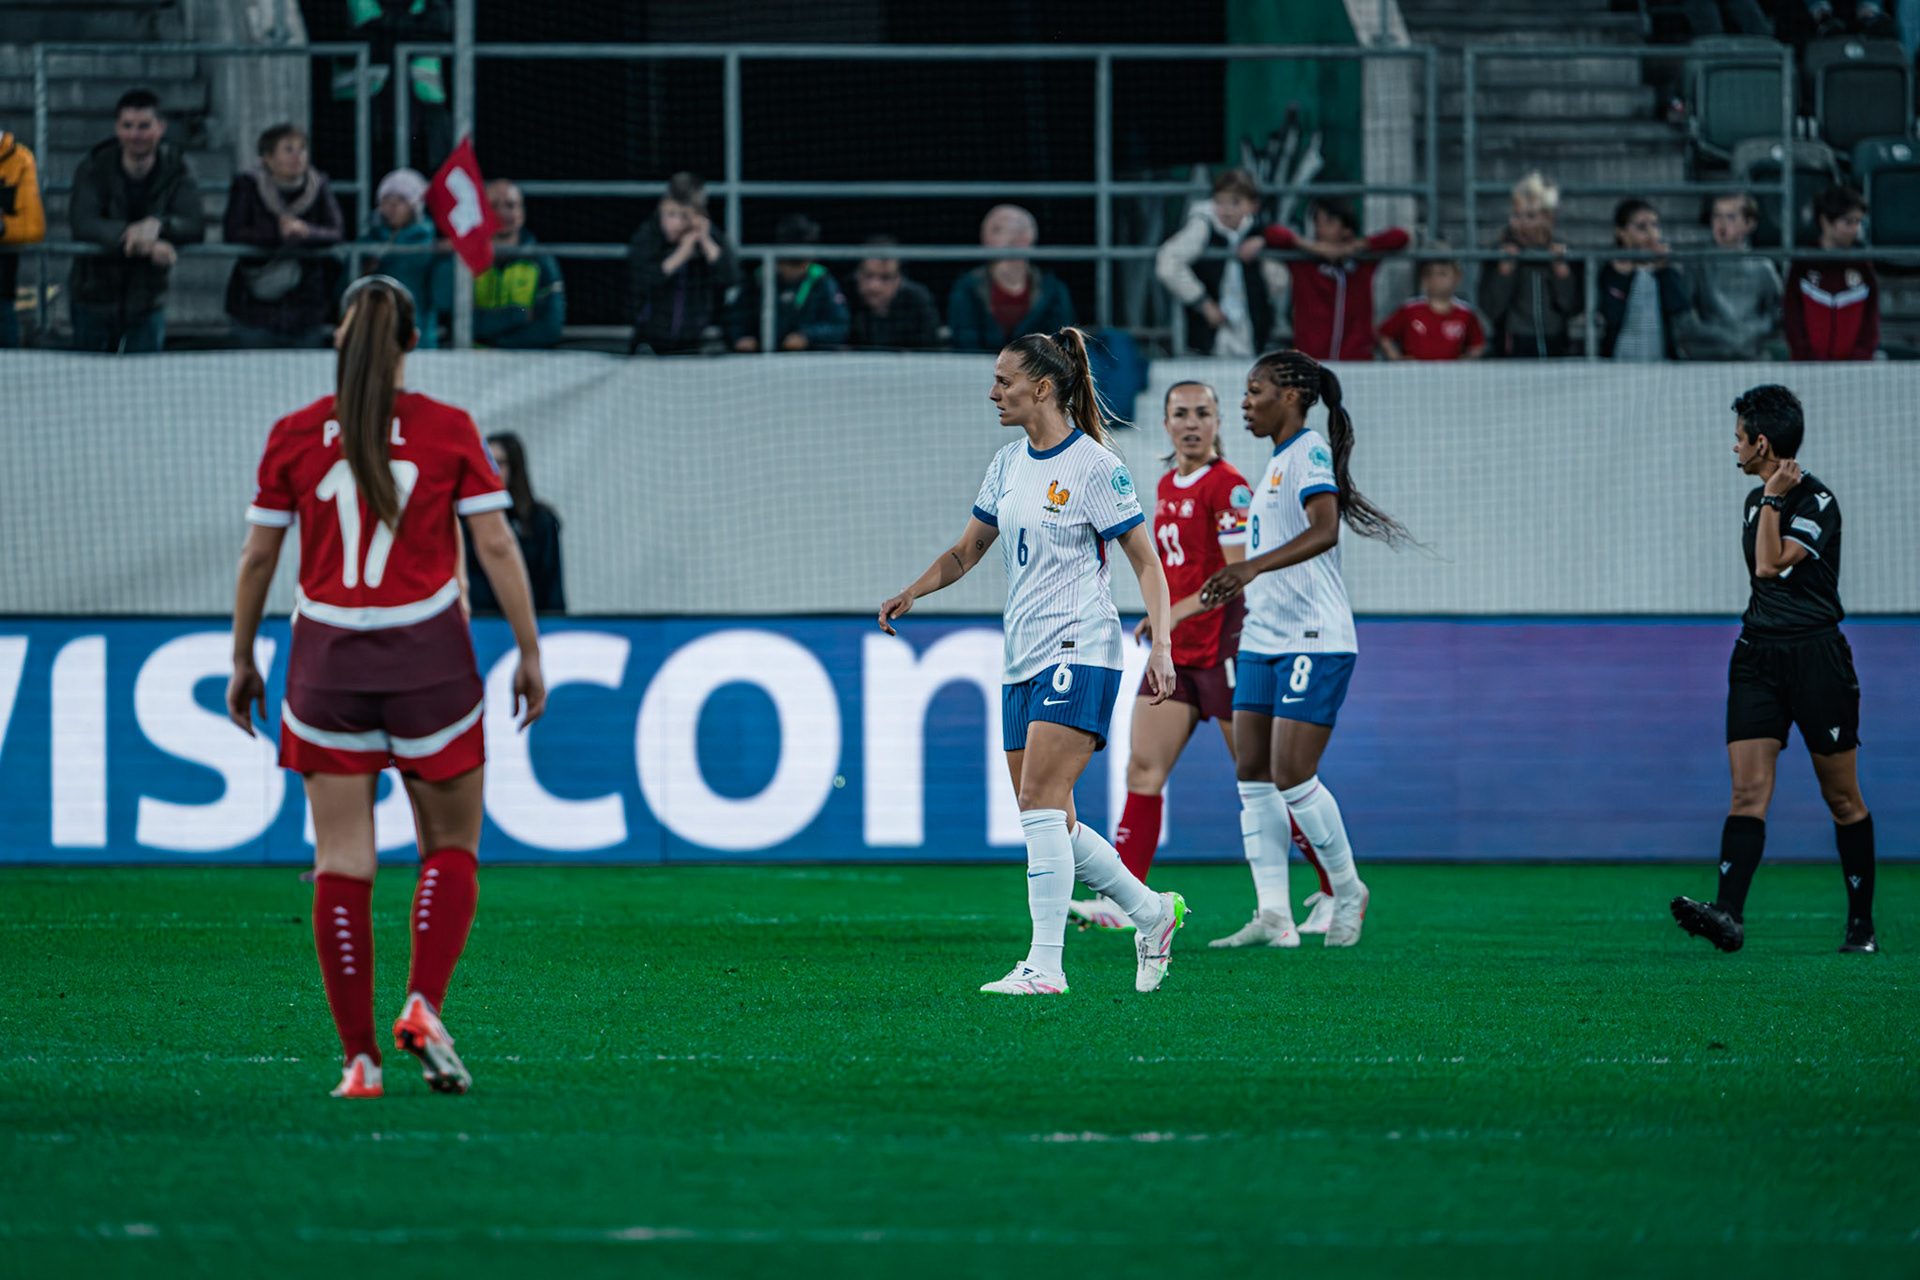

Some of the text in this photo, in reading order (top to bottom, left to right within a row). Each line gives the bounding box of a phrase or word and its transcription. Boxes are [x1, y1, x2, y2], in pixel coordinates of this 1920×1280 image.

[315, 459, 419, 589] 17
[1157, 522, 1185, 567] 13
[1017, 527, 1029, 568] 6
[1052, 661, 1073, 694] 6
[1289, 654, 1313, 693] 8
